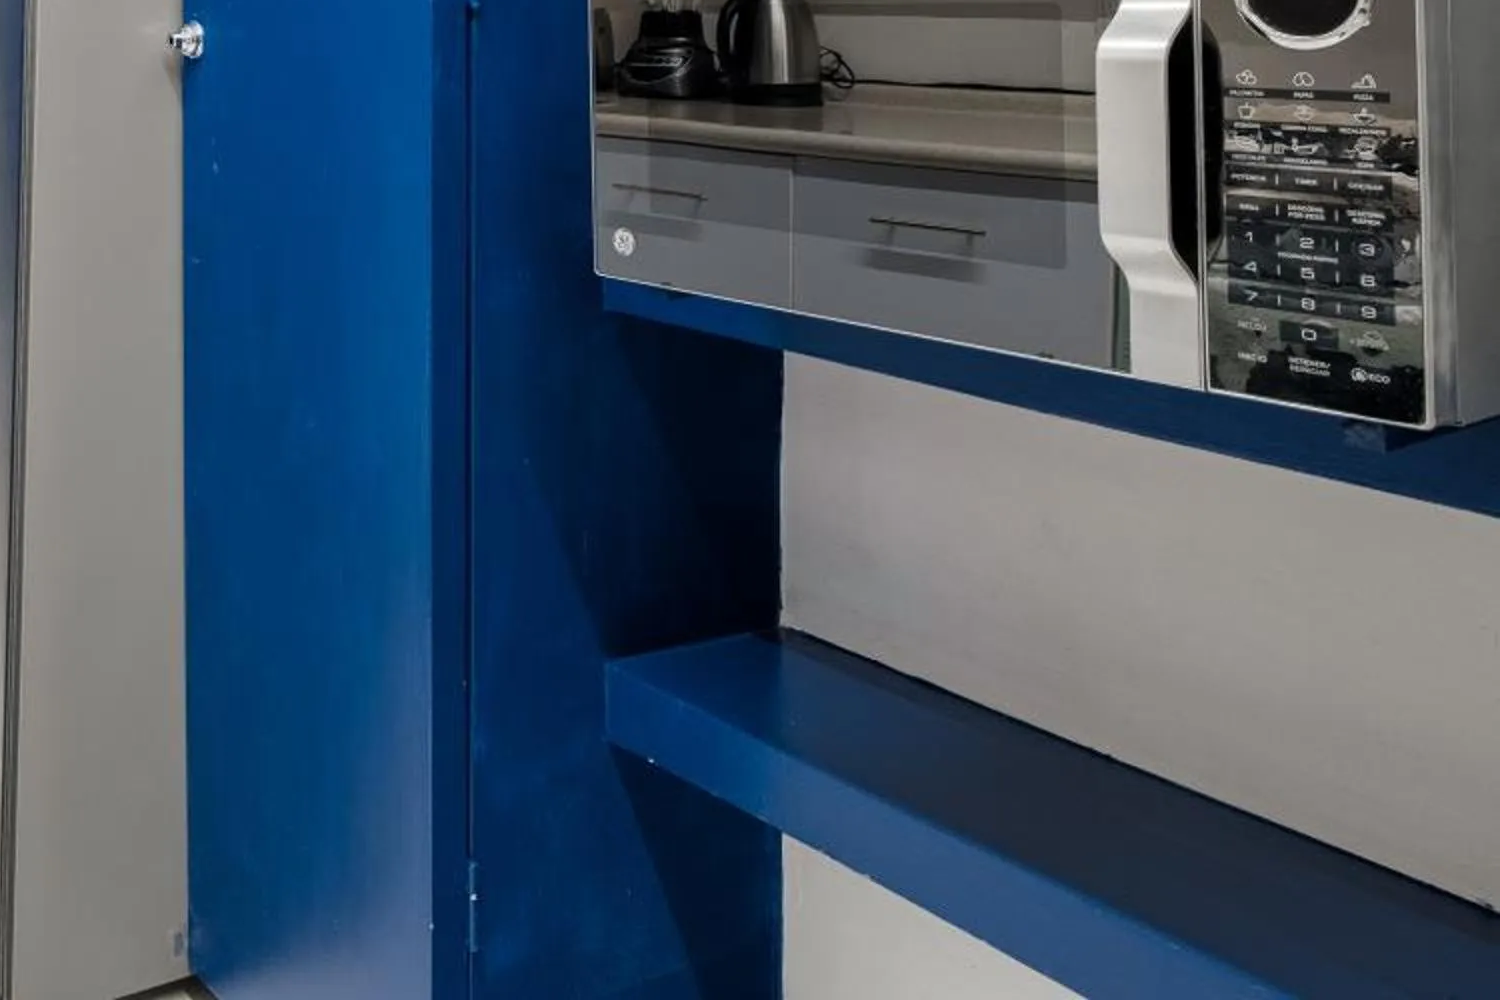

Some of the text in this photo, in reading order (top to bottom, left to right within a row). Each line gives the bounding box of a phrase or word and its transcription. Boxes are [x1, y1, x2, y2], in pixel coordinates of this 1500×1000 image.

[1244, 231, 1253, 244] 1
[1300, 236, 1315, 250] 2
[1358, 242, 1376, 258] 3
[1243, 260, 1258, 274] 4
[1301, 266, 1315, 280] 5
[1361, 274, 1377, 288] 6
[1244, 289, 1259, 303] 7
[1301, 297, 1316, 311] 8
[1361, 305, 1377, 320] 9
